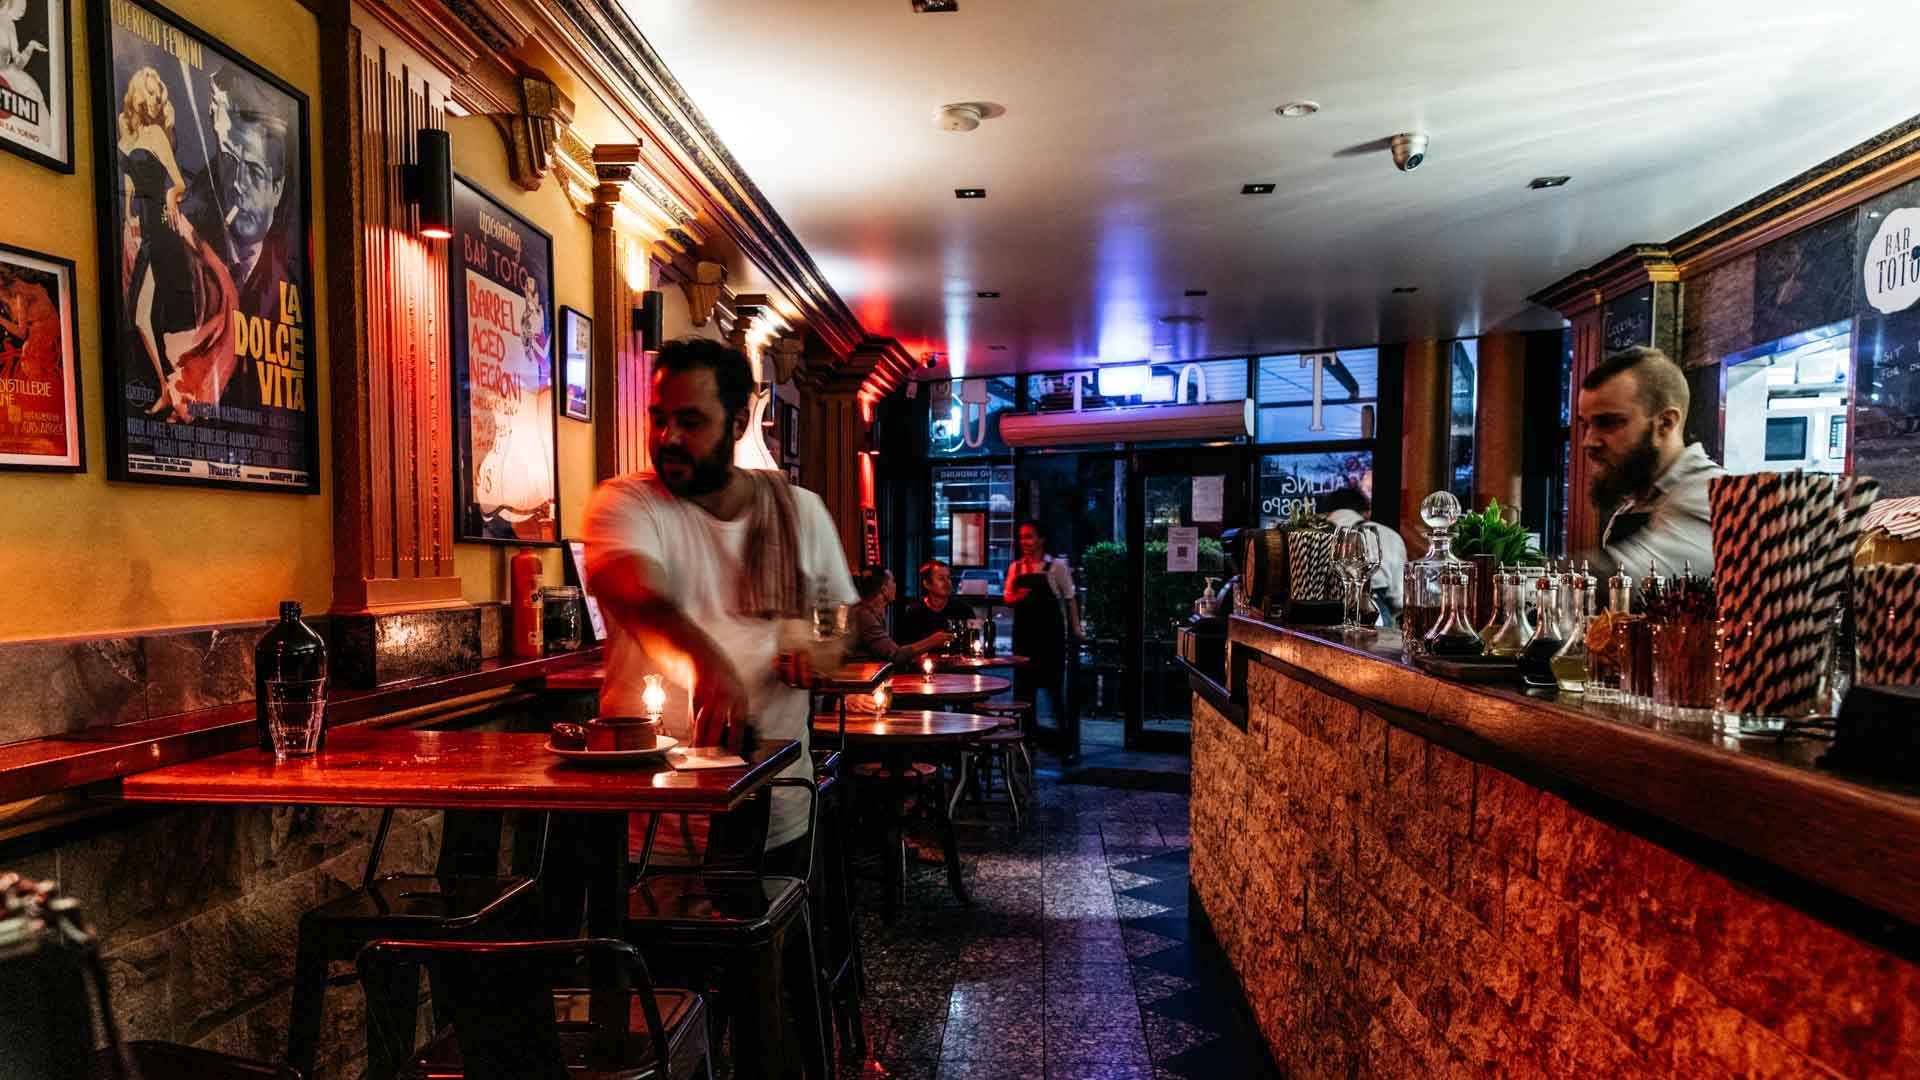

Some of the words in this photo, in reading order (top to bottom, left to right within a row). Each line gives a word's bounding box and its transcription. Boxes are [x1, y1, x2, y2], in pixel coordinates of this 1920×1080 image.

[464, 232, 488, 271] BAR
[492, 250, 529, 290] TOTO
[480, 211, 523, 264] upcoming
[1885, 227, 1911, 257] BAR
[279, 280, 303, 326] LA
[468, 279, 521, 337] BARREL
[233, 309, 304, 370] DOLCE
[255, 360, 305, 412] VITA
